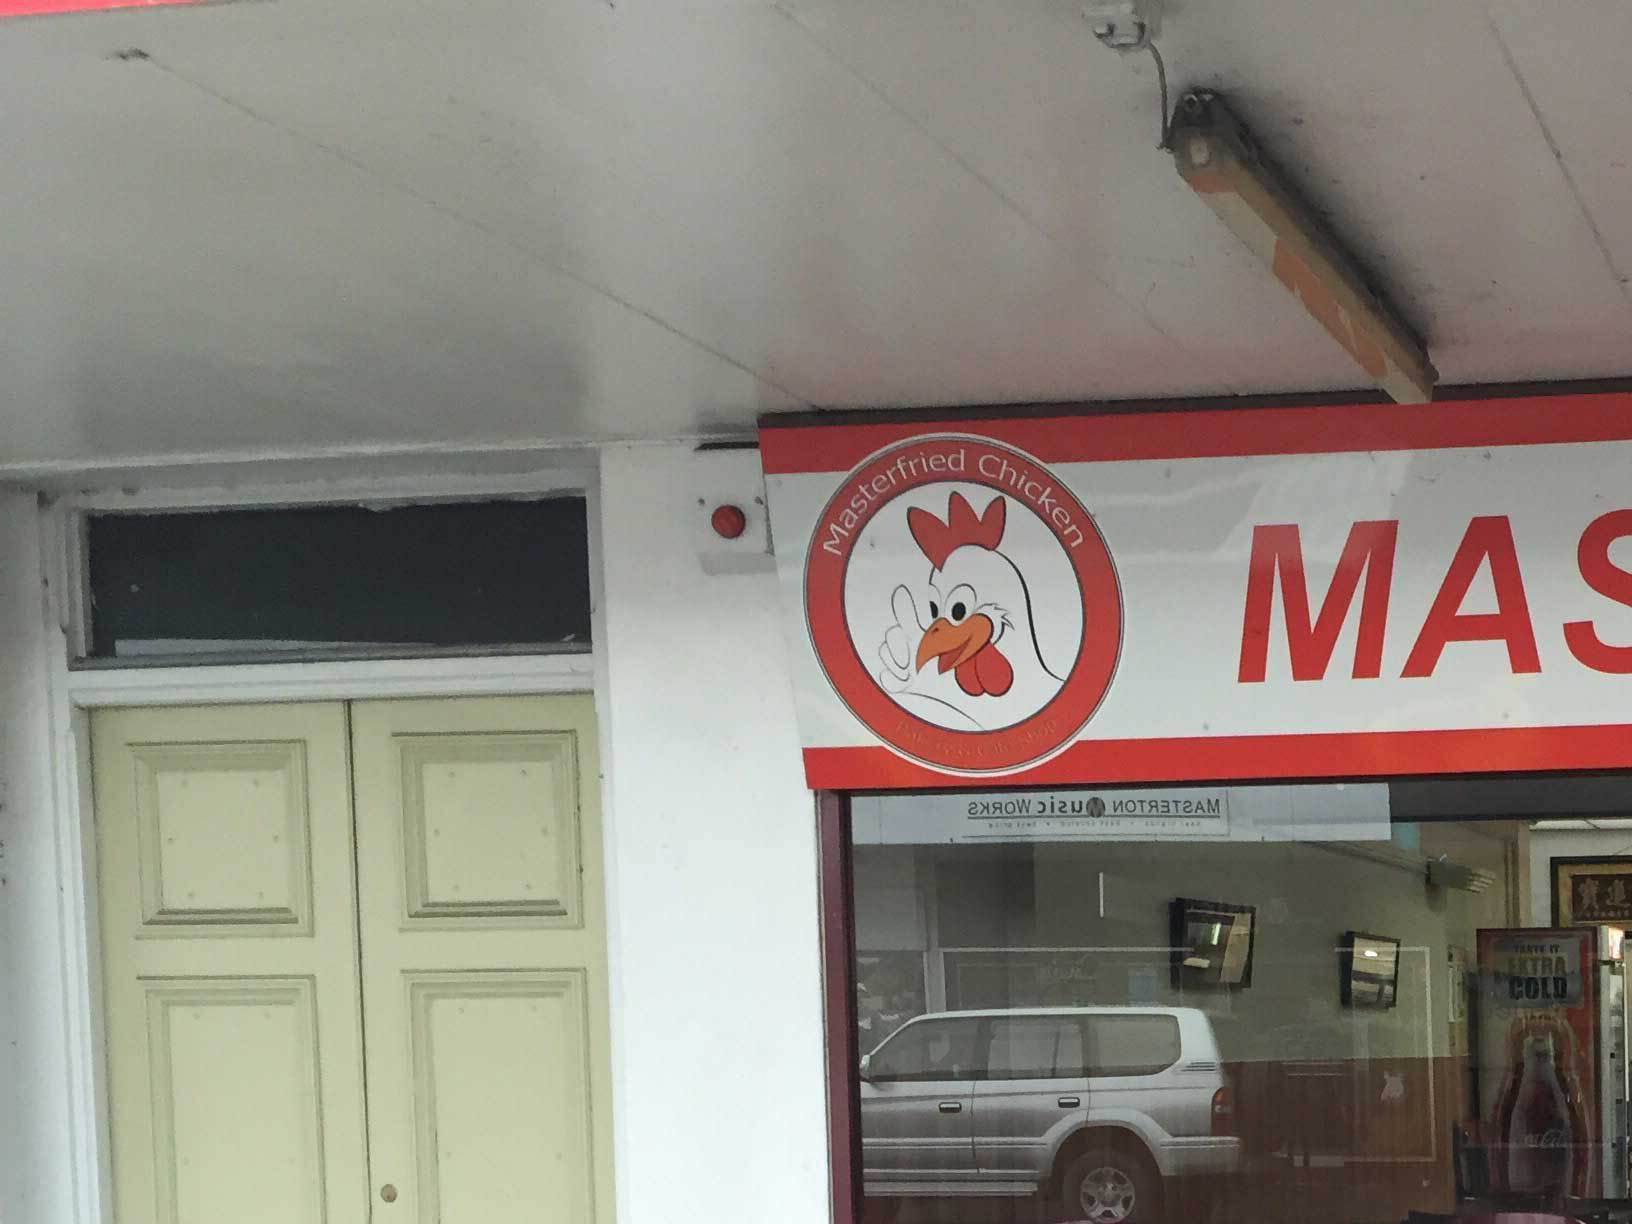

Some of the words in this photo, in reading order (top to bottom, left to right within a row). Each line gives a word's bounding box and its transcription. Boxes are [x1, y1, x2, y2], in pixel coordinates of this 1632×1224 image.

[823, 448, 966, 557] Masterfried
[977, 453, 1085, 549] Chicken
[1508, 976, 1568, 1000] COLD
